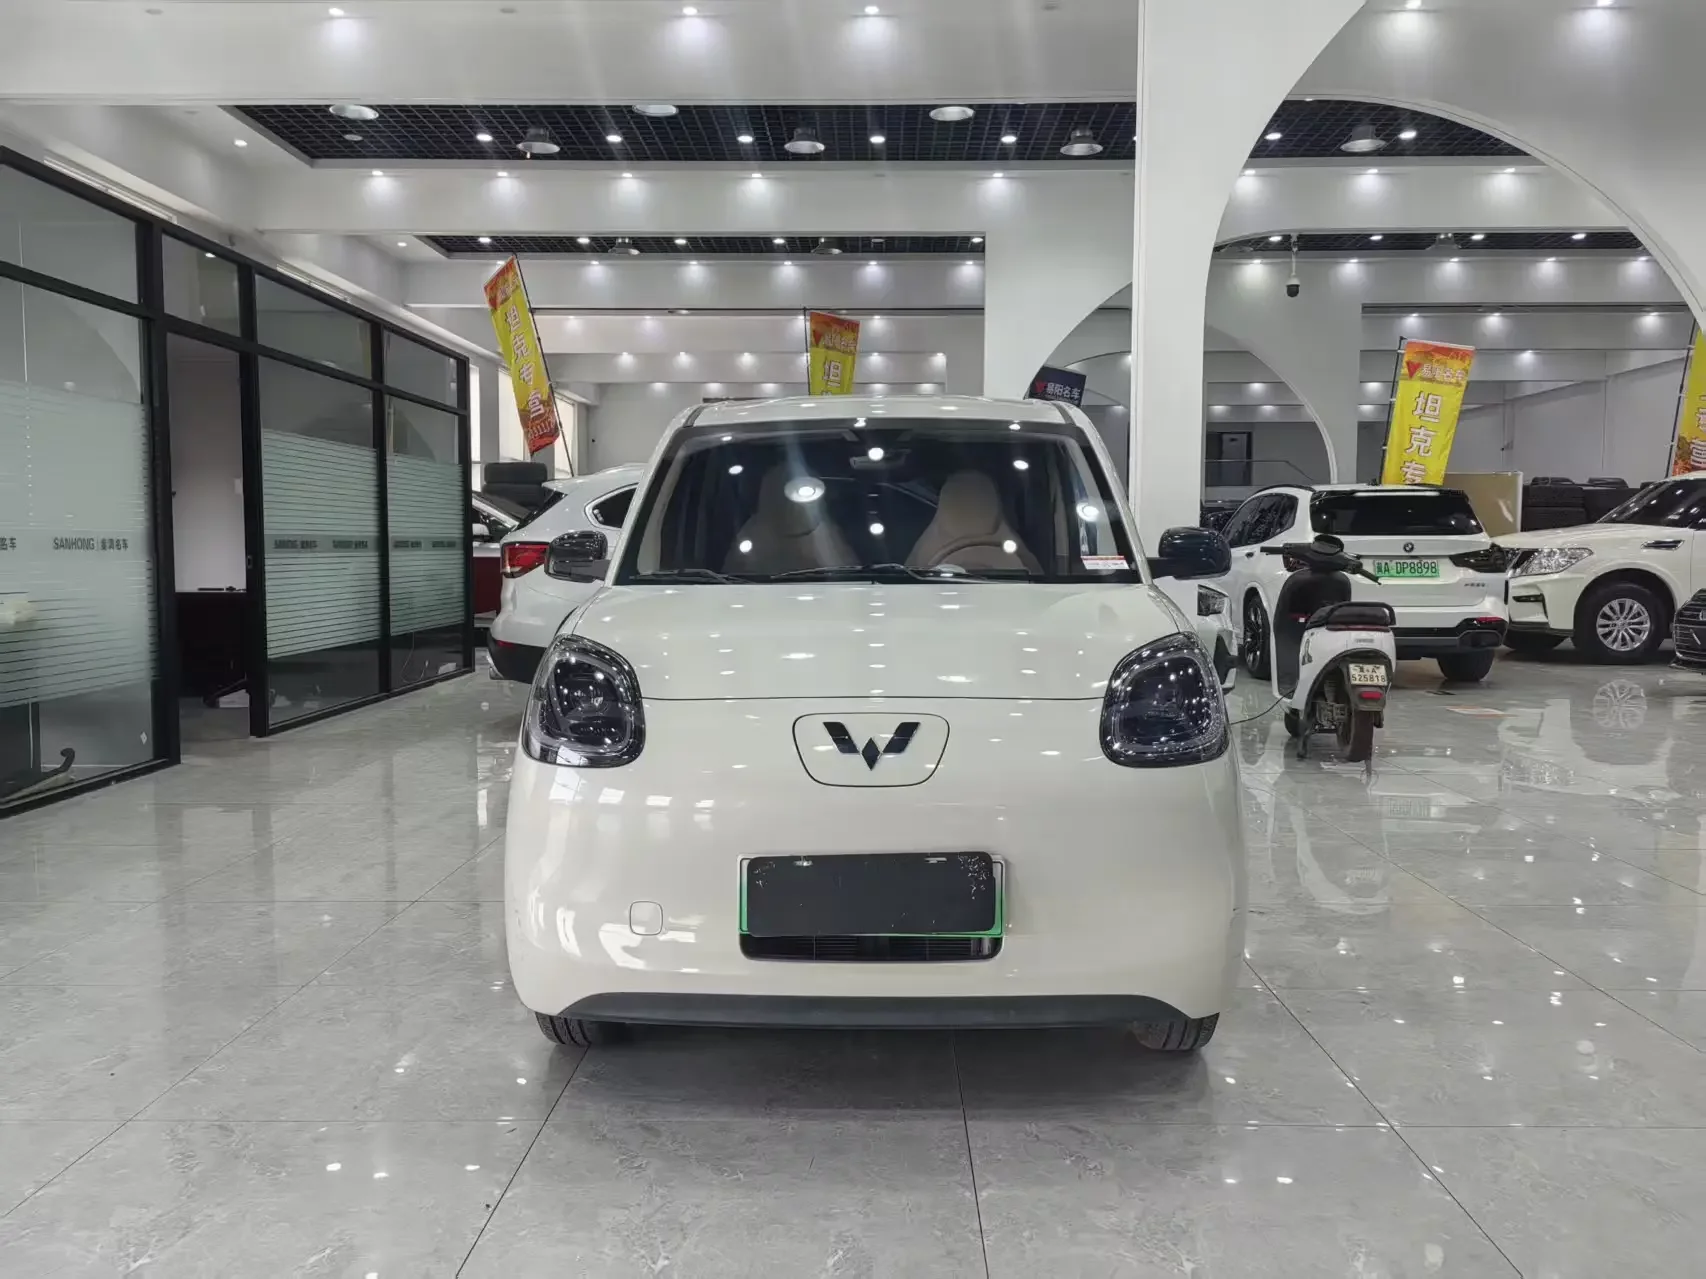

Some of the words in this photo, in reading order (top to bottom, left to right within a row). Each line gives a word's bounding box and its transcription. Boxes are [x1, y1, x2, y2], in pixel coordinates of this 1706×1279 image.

[822, 360, 842, 395] 坦
[53, 537, 95, 551] SANHONG
[1395, 561, 1437, 575] DP8898
